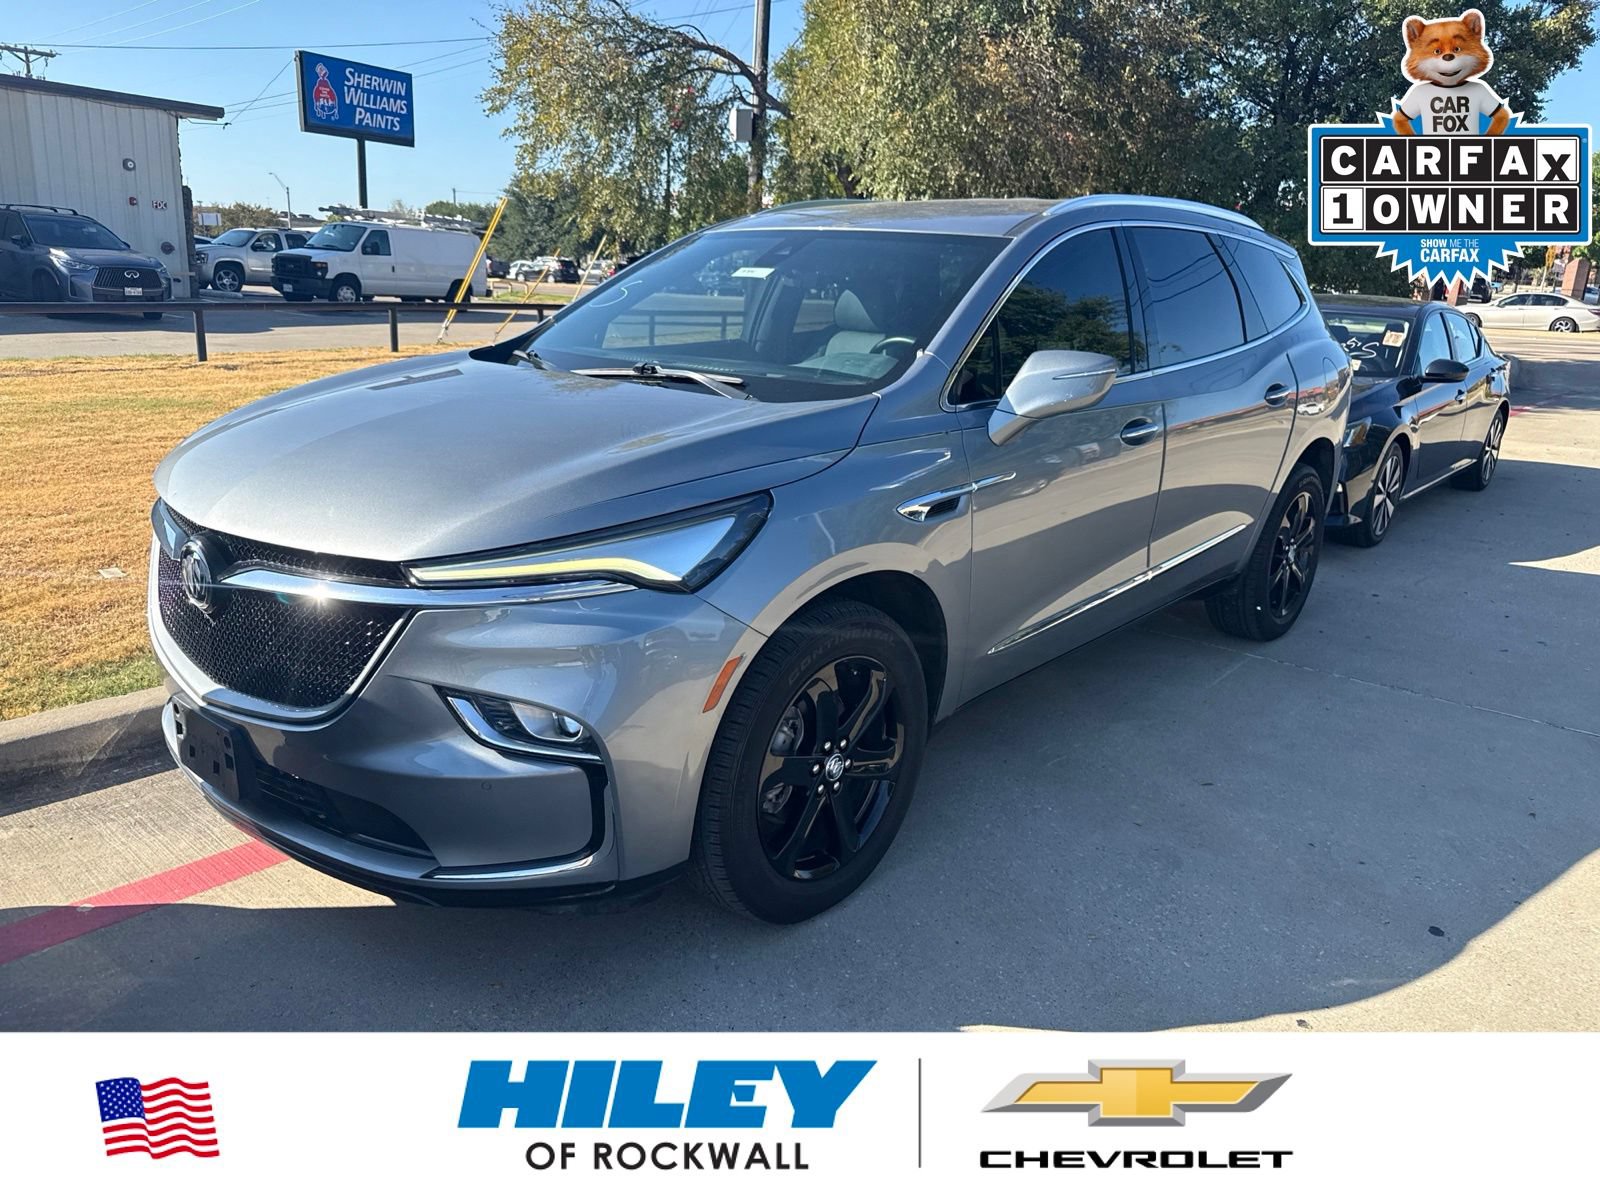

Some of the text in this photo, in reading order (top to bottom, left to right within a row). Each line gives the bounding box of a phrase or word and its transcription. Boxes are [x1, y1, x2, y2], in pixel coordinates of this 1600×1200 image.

[344, 67, 407, 97] SHERWIN
[343, 85, 408, 115] WILLIAMS
[354, 107, 401, 131] PAINTS
[151, 200, 168, 210] FDC
